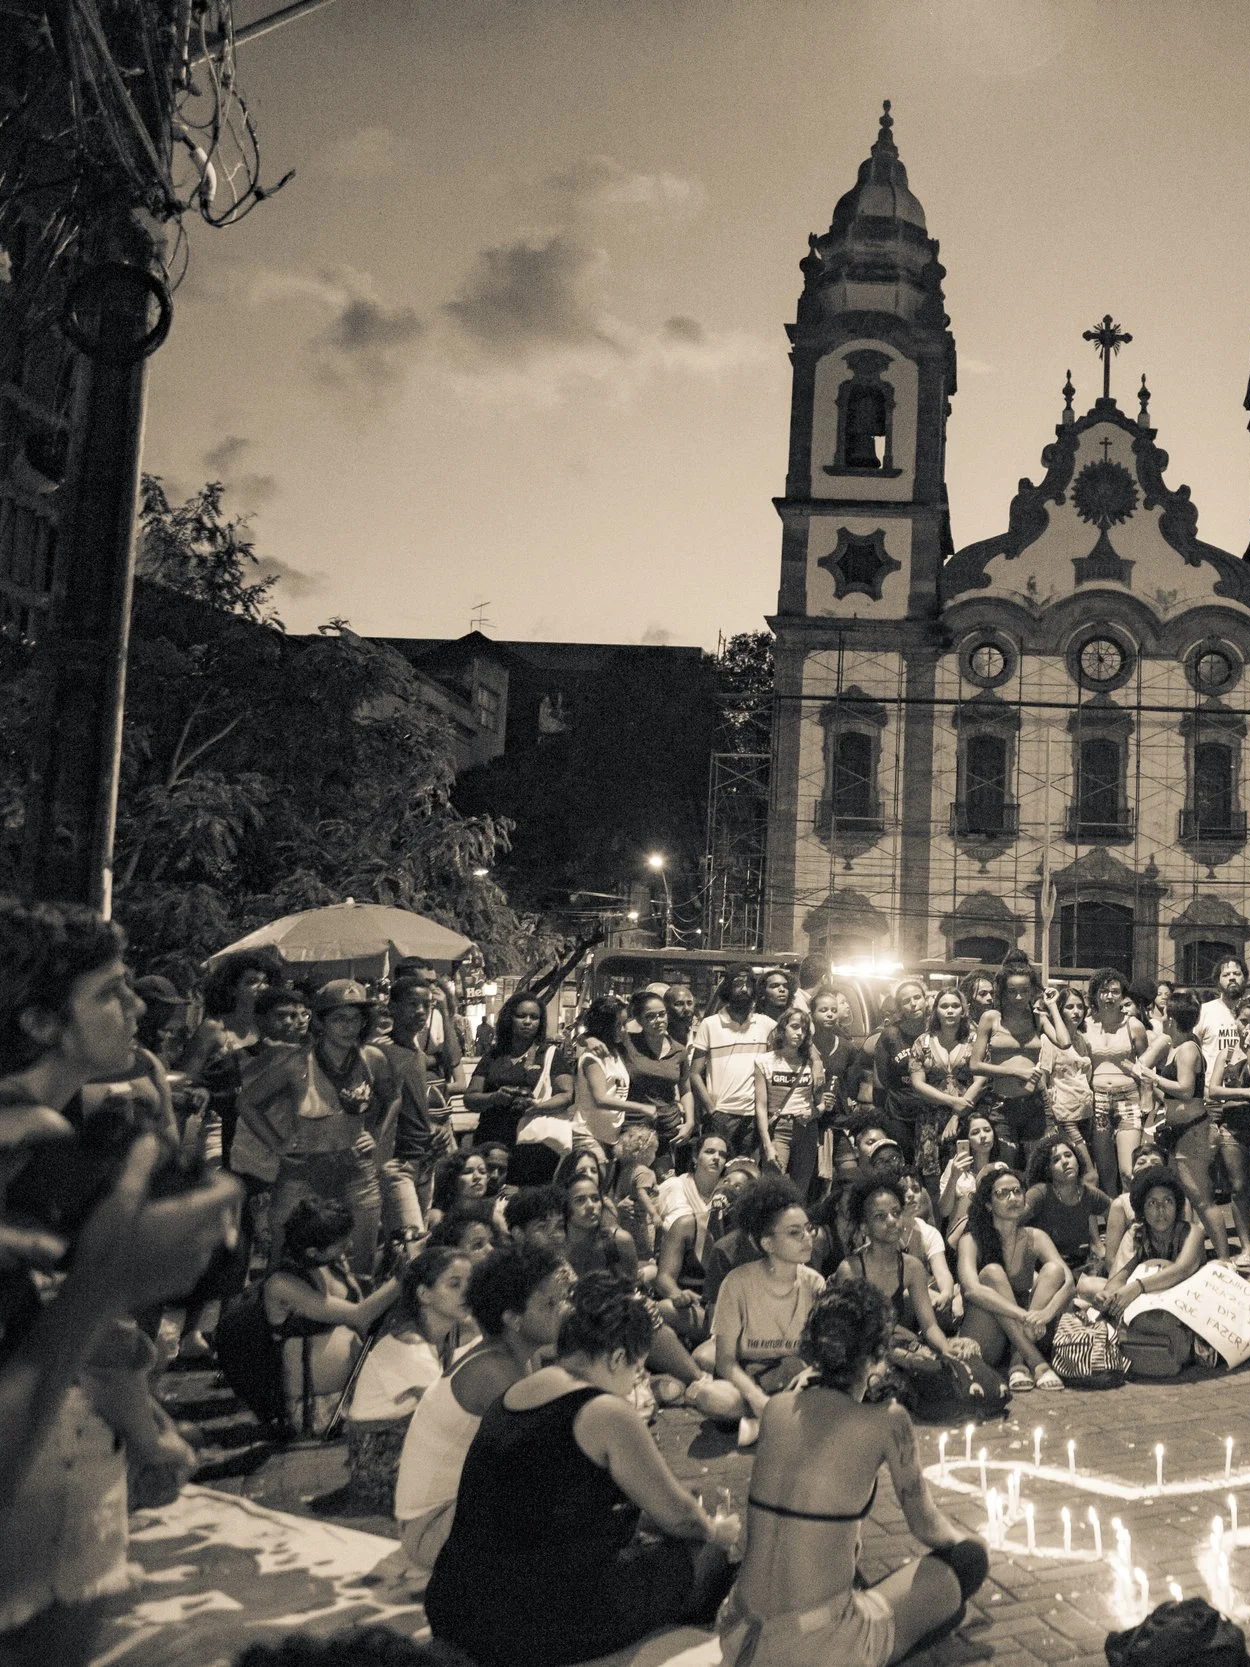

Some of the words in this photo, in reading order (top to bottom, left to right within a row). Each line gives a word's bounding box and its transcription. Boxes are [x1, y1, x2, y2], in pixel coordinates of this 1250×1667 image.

[1174, 1299, 1199, 1318] QUE
[1206, 1317, 1250, 1355] FAZER!
[1217, 1304, 1237, 1321] DIZ
